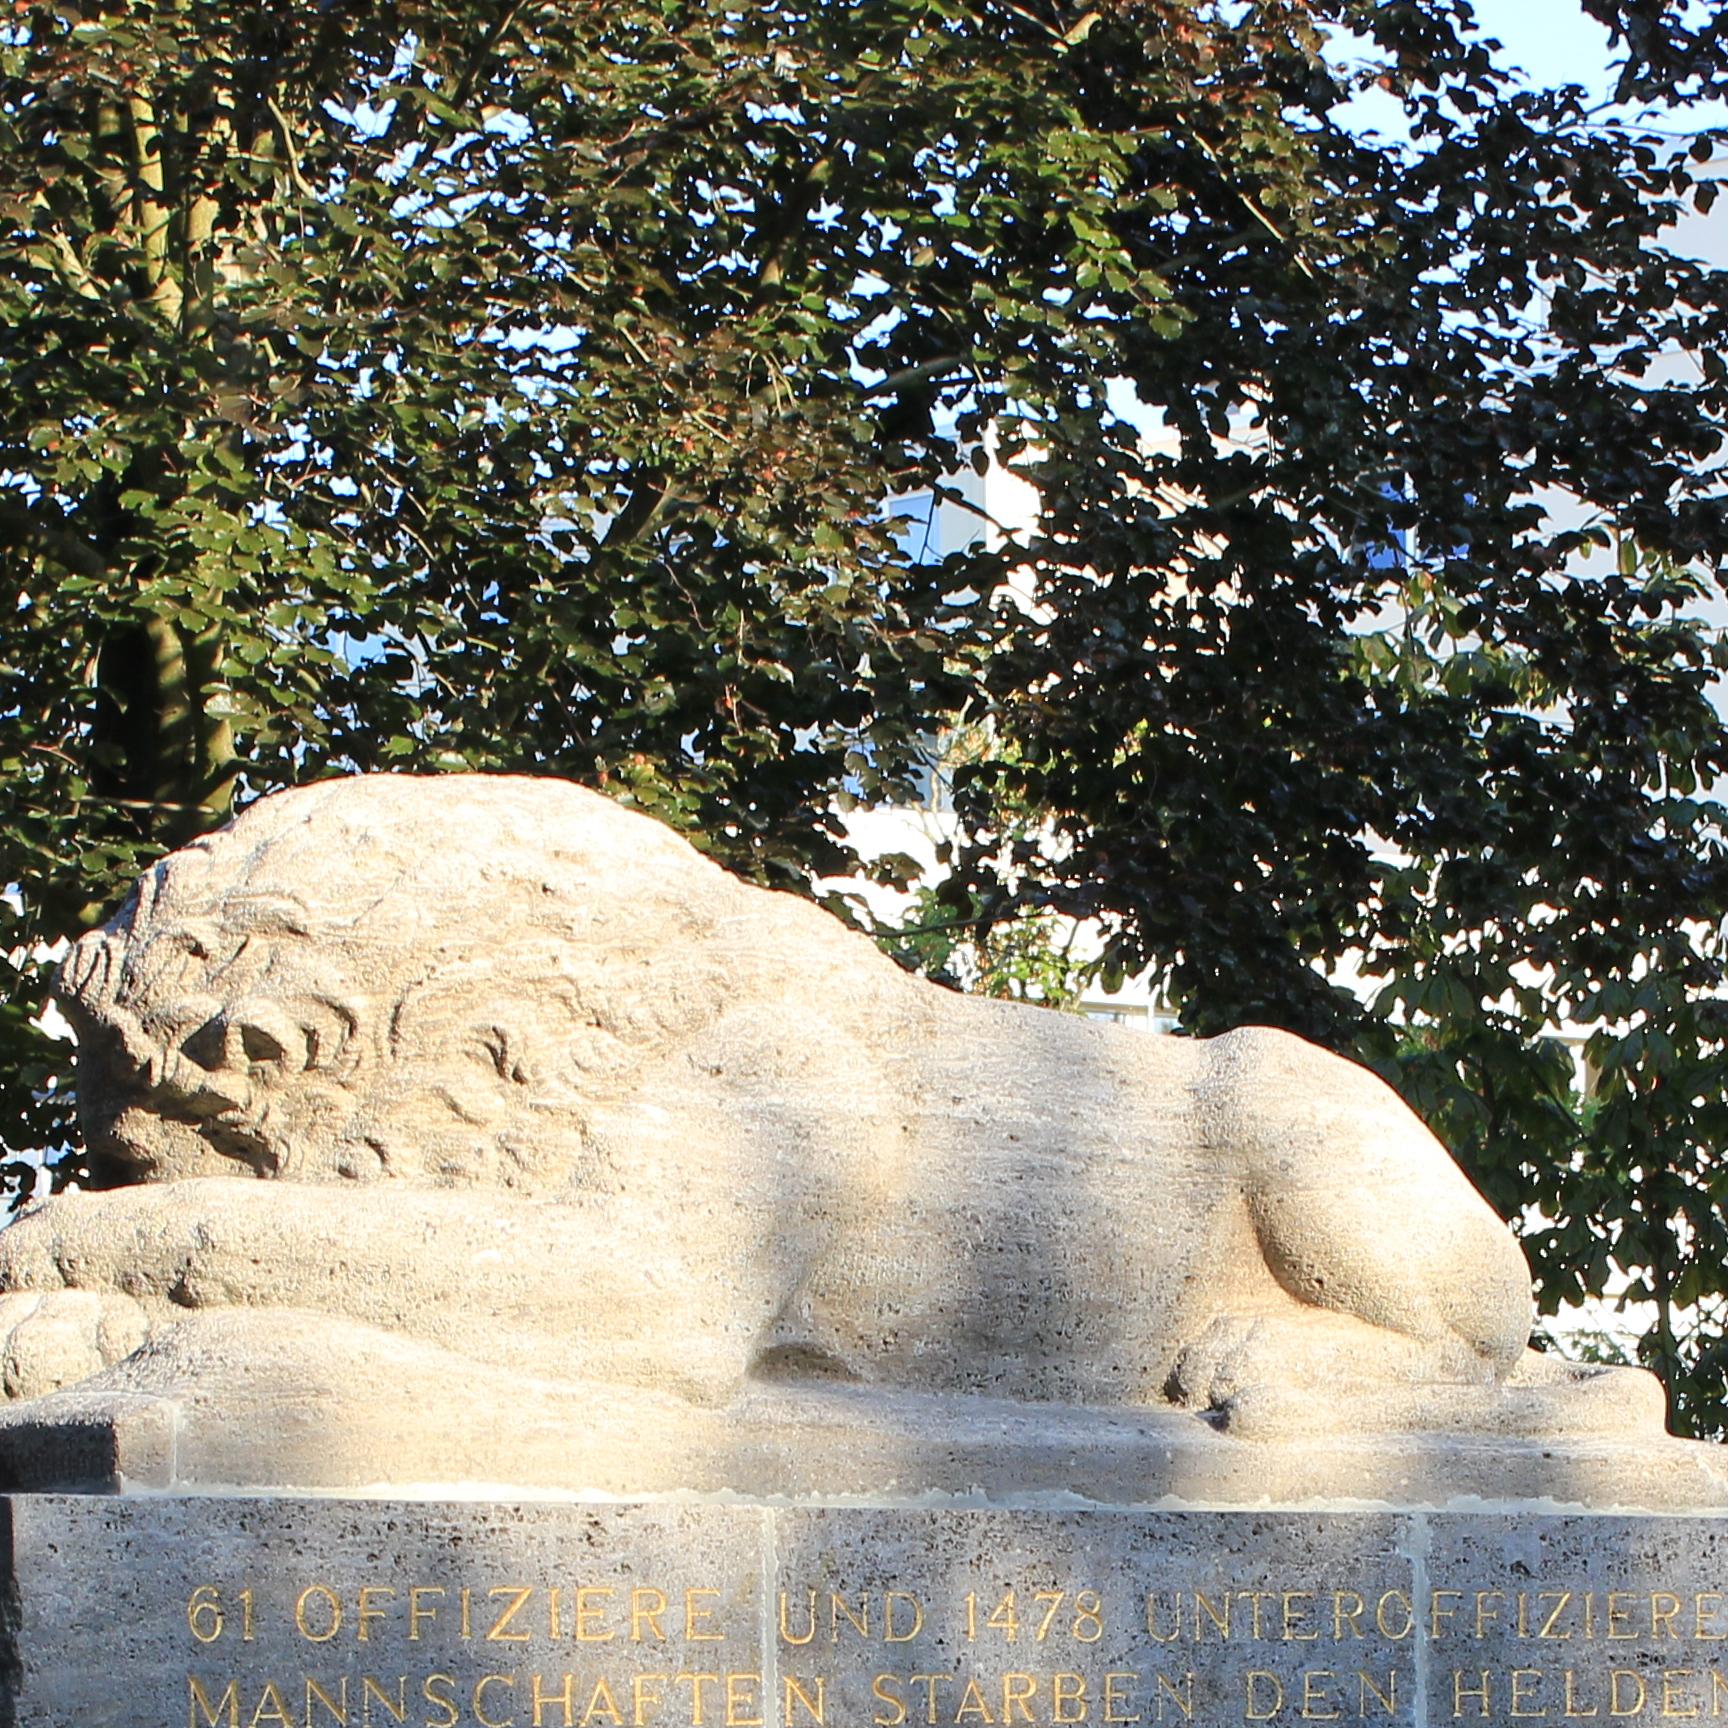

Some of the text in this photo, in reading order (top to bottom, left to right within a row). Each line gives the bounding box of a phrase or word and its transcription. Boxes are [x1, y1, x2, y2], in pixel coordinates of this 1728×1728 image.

[188, 1586, 256, 1643] 61
[294, 1585, 726, 1643] OFFIZIERE
[779, 1591, 926, 1646] UND
[964, 1590, 1104, 1643] 1478
[1146, 1590, 1728, 1643] UNTEROFFIZIERE
[874, 1673, 1196, 1727] STARBEN
[1244, 1670, 1399, 1721] DEN
